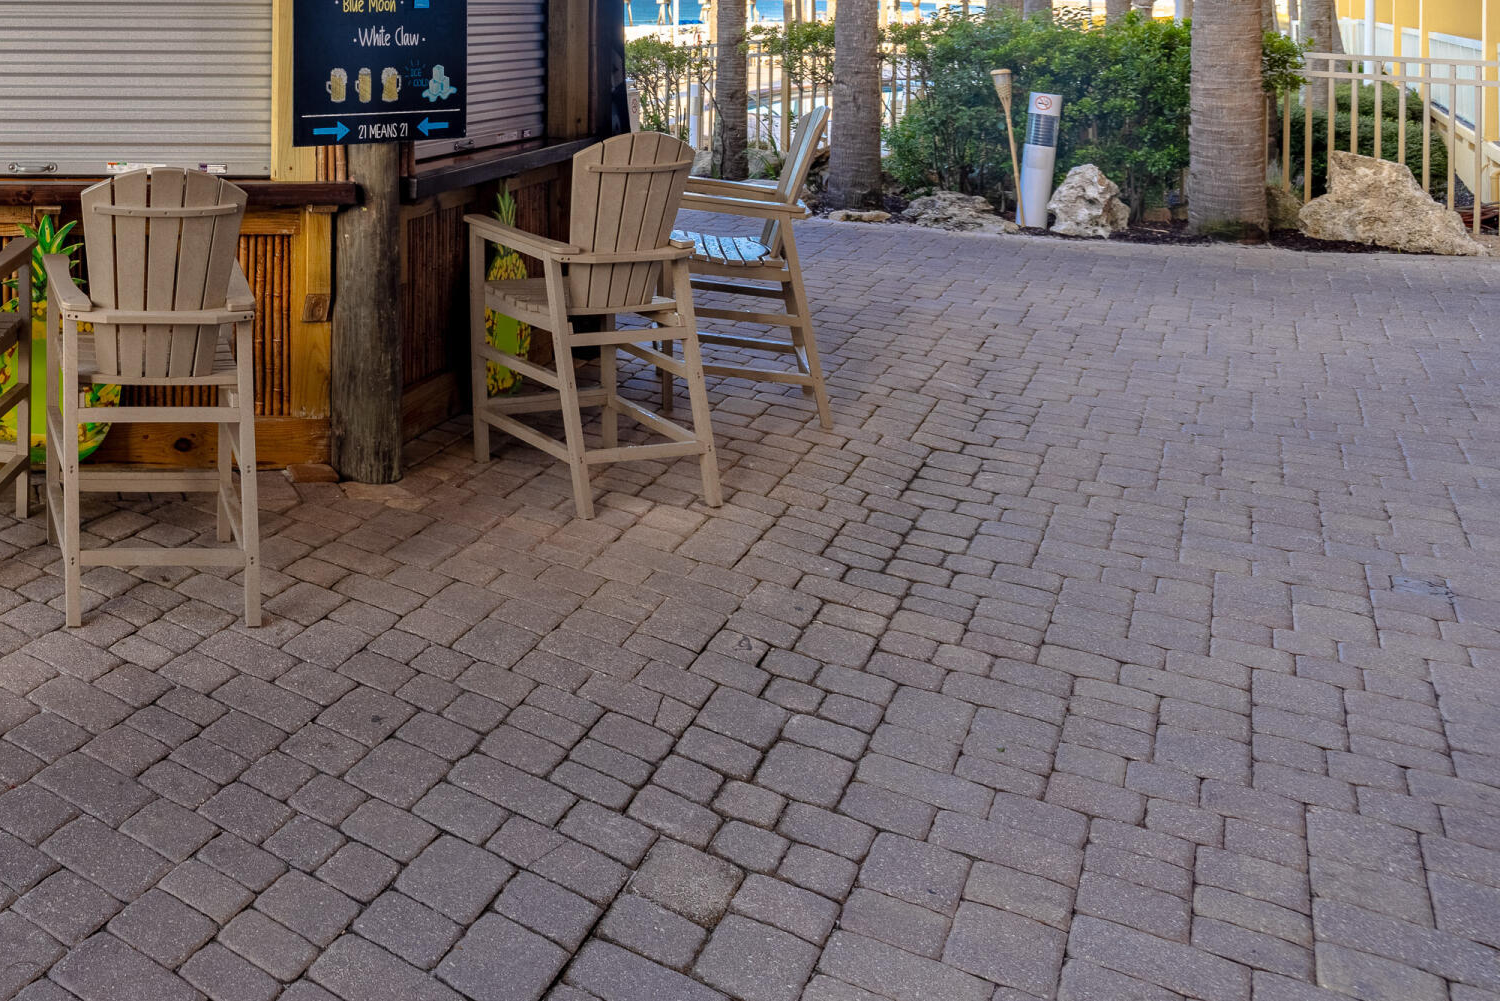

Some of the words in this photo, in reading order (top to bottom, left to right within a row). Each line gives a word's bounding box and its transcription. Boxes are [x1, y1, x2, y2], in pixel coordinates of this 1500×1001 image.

[358, 25, 391, 47] White
[394, 26, 420, 47] Claw
[410, 67, 422, 78] ICE
[358, 125, 367, 140] 21
[369, 123, 398, 139] MEANS
[399, 122, 409, 137] 21
